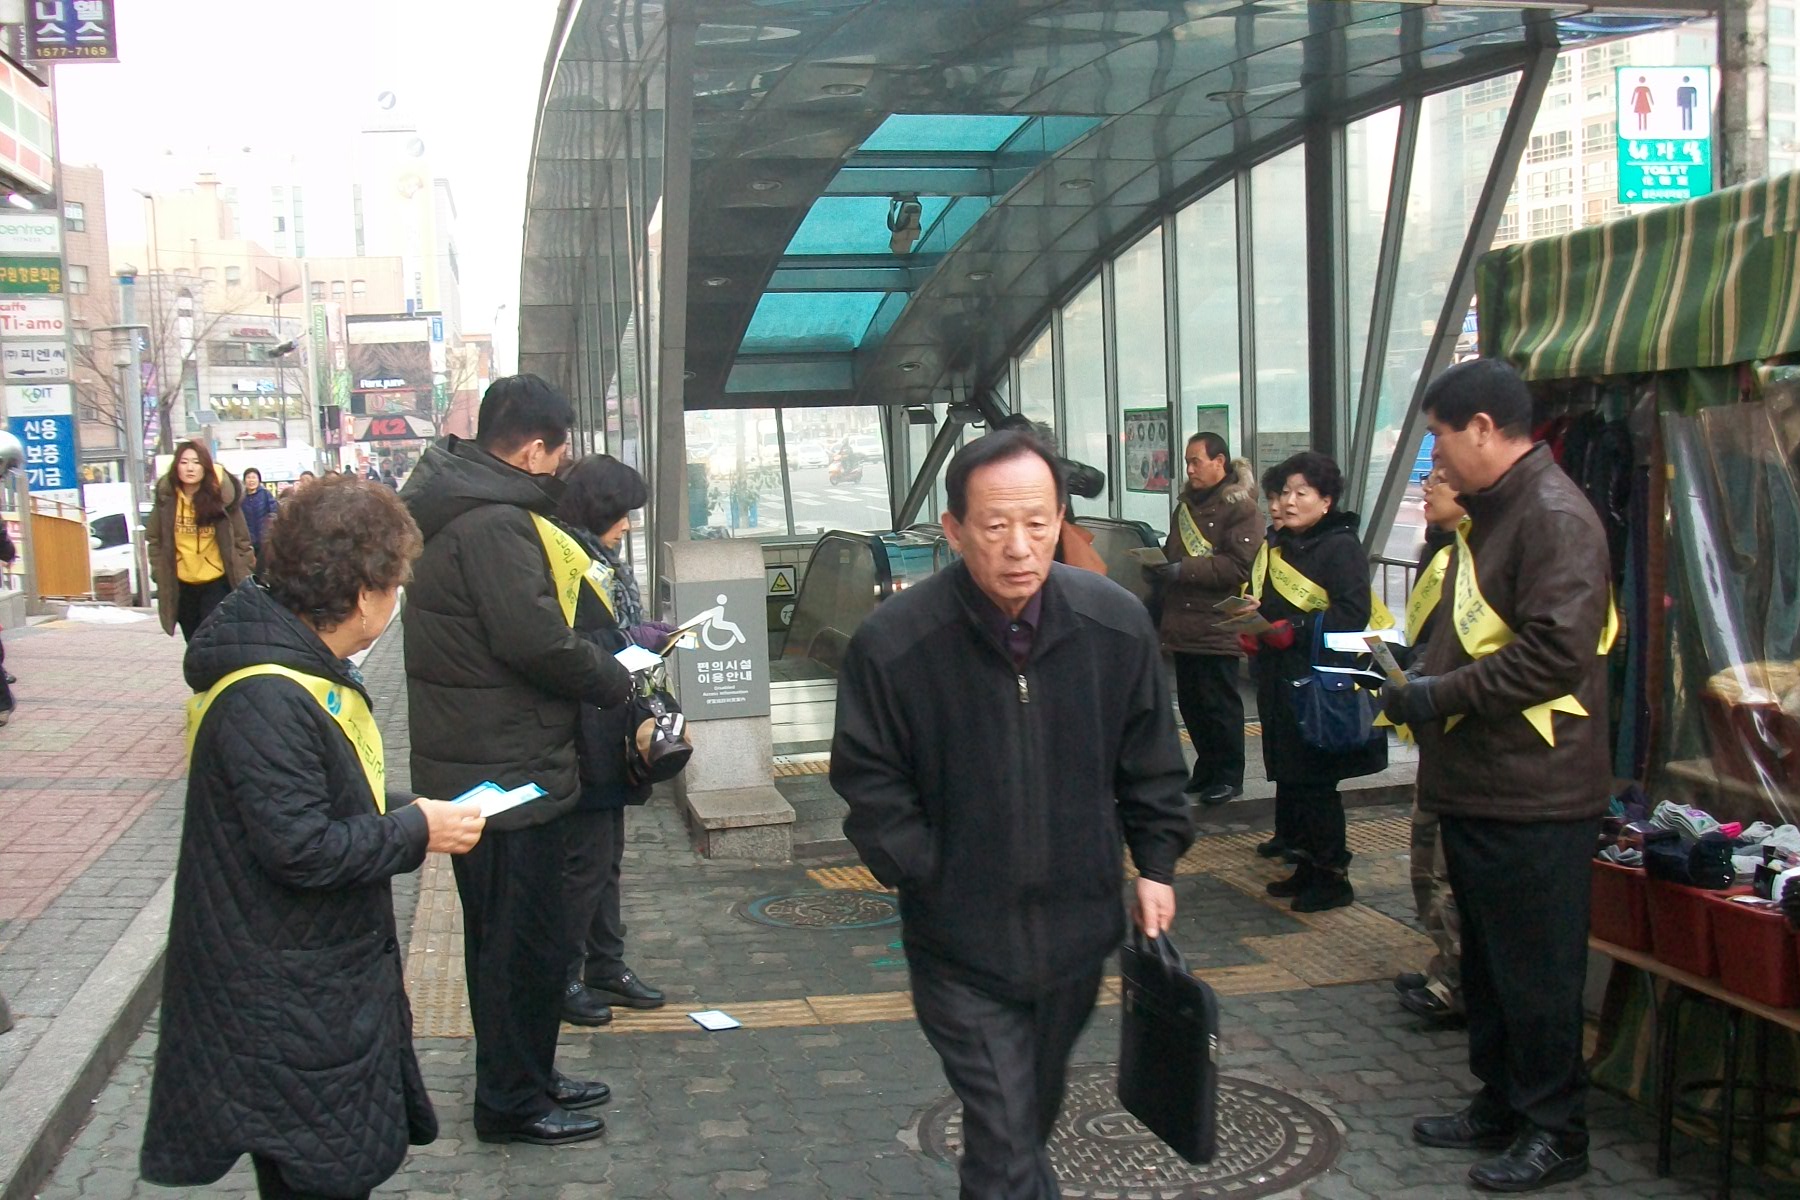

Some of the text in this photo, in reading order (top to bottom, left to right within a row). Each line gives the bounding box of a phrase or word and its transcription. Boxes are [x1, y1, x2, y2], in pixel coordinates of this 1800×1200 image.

[36, 47, 108, 57] 1577-7169
[48, 283, 60, 293] 3F
[0, 315, 63, 330] Ti-amo
[49, 368, 65, 376] 13F
[24, 419, 58, 440] 신용
[371, 419, 407, 436] K2
[26, 444, 60, 464] 보증
[24, 468, 61, 487] 기금
[697, 659, 752, 673] 편의시설
[697, 670, 752, 684] 이용안내
